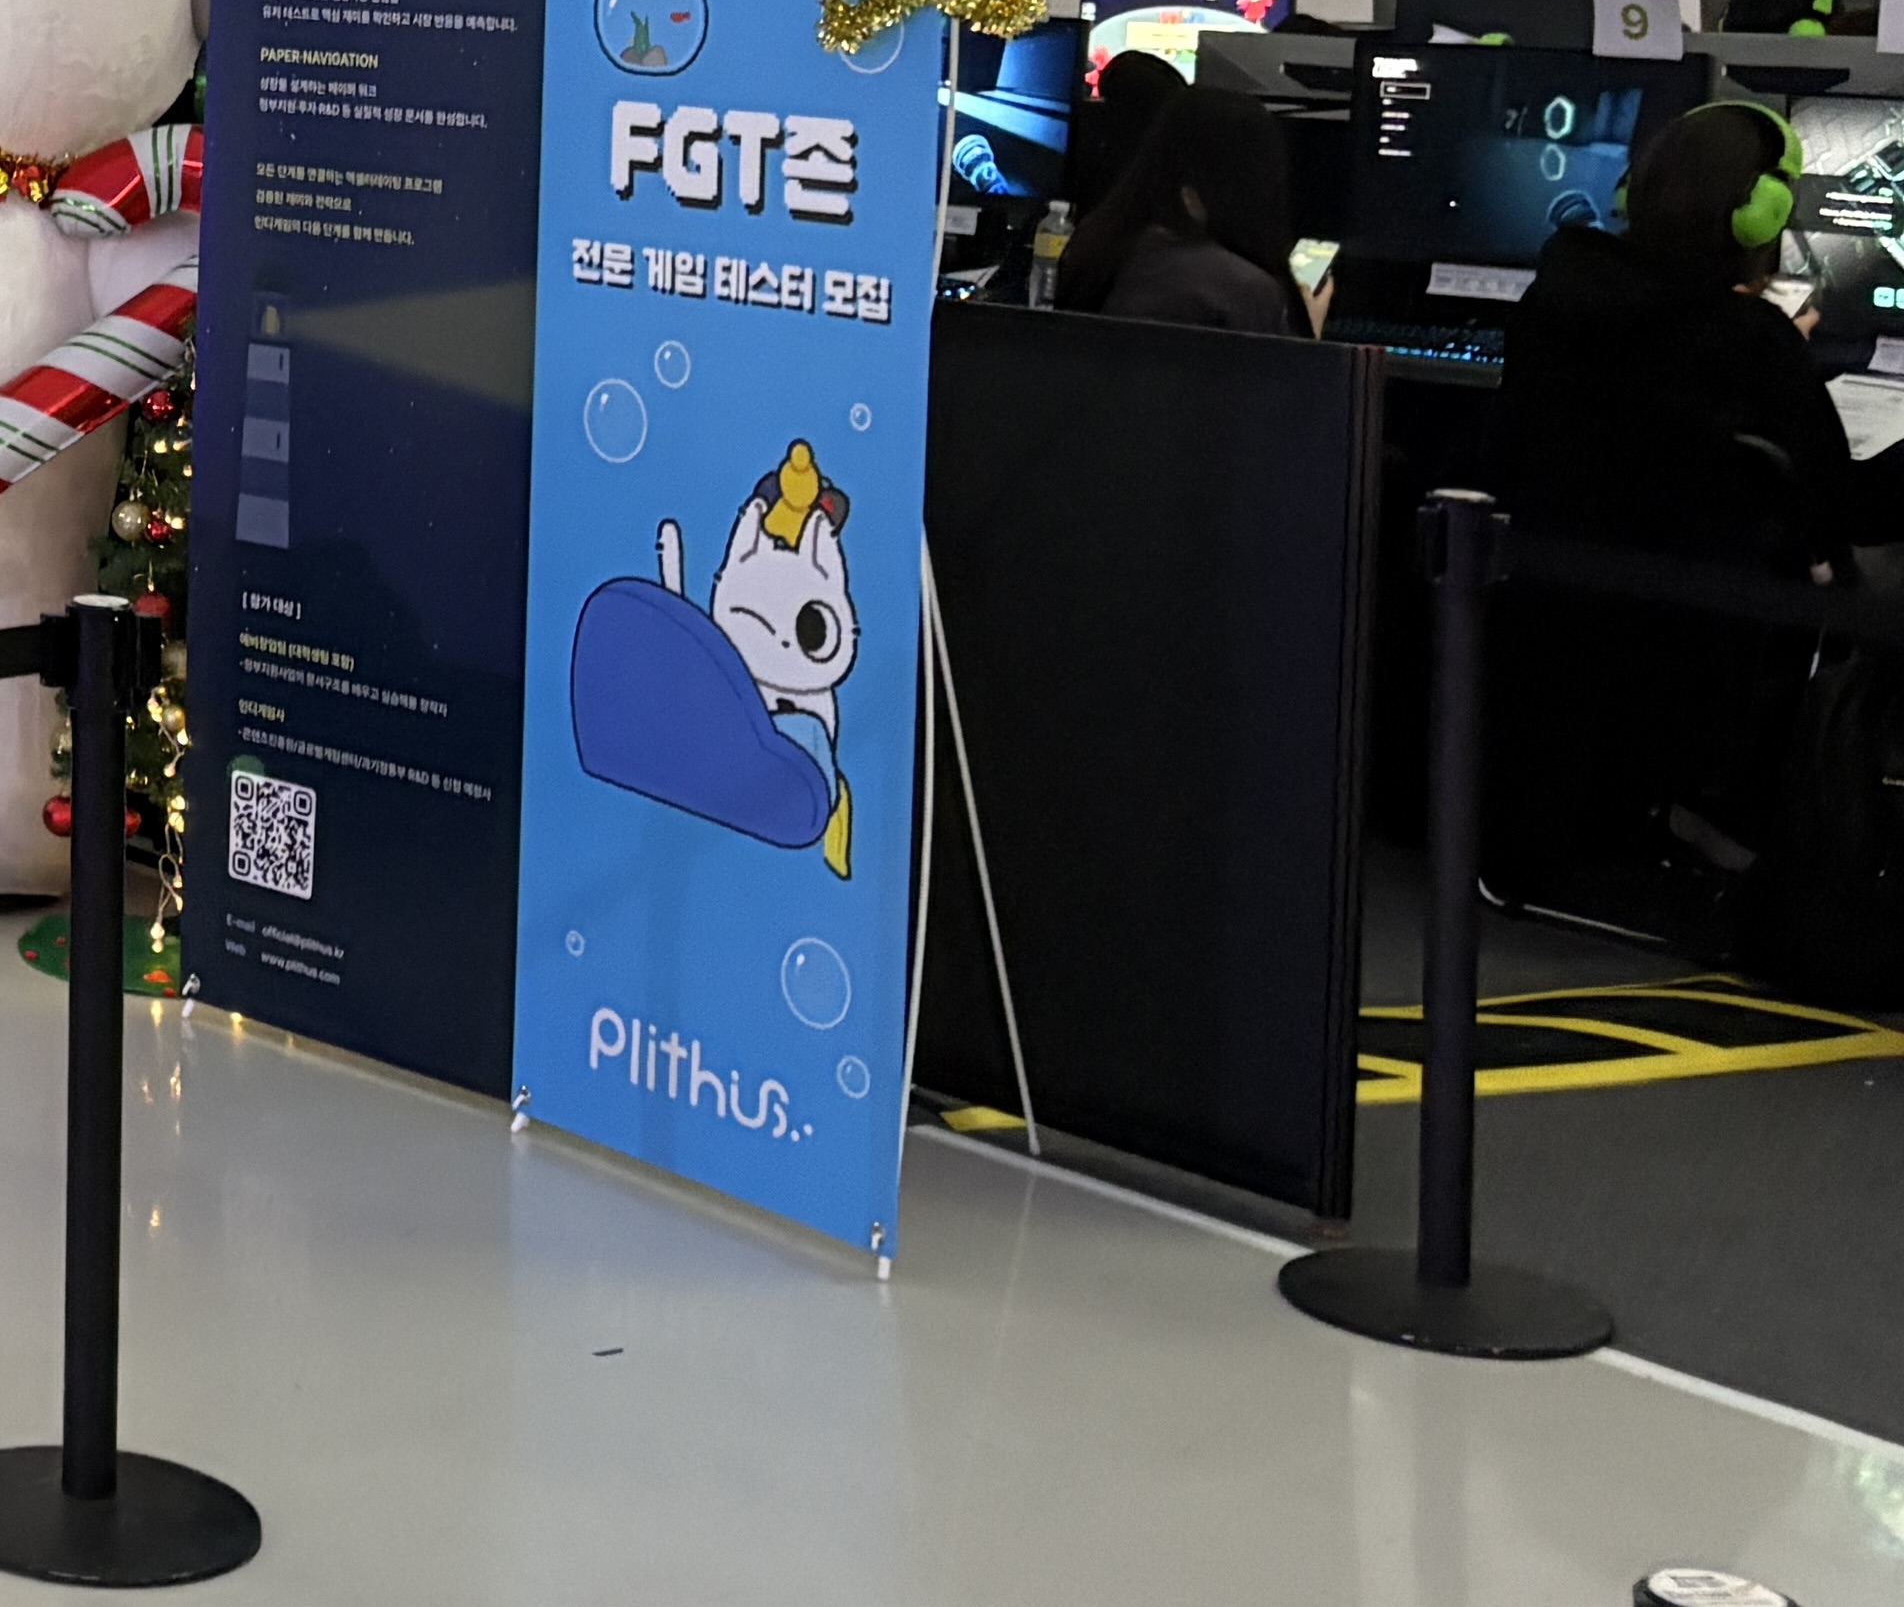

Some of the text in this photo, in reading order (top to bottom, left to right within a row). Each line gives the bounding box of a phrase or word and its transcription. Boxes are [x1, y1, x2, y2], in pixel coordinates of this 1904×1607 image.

[1621, 3, 1648, 40] 9
[260, 48, 378, 68] PAPER NAVIGATION
[610, 100, 856, 220] FGT존
[572, 237, 891, 321] 전문 게임 테스터 모집
